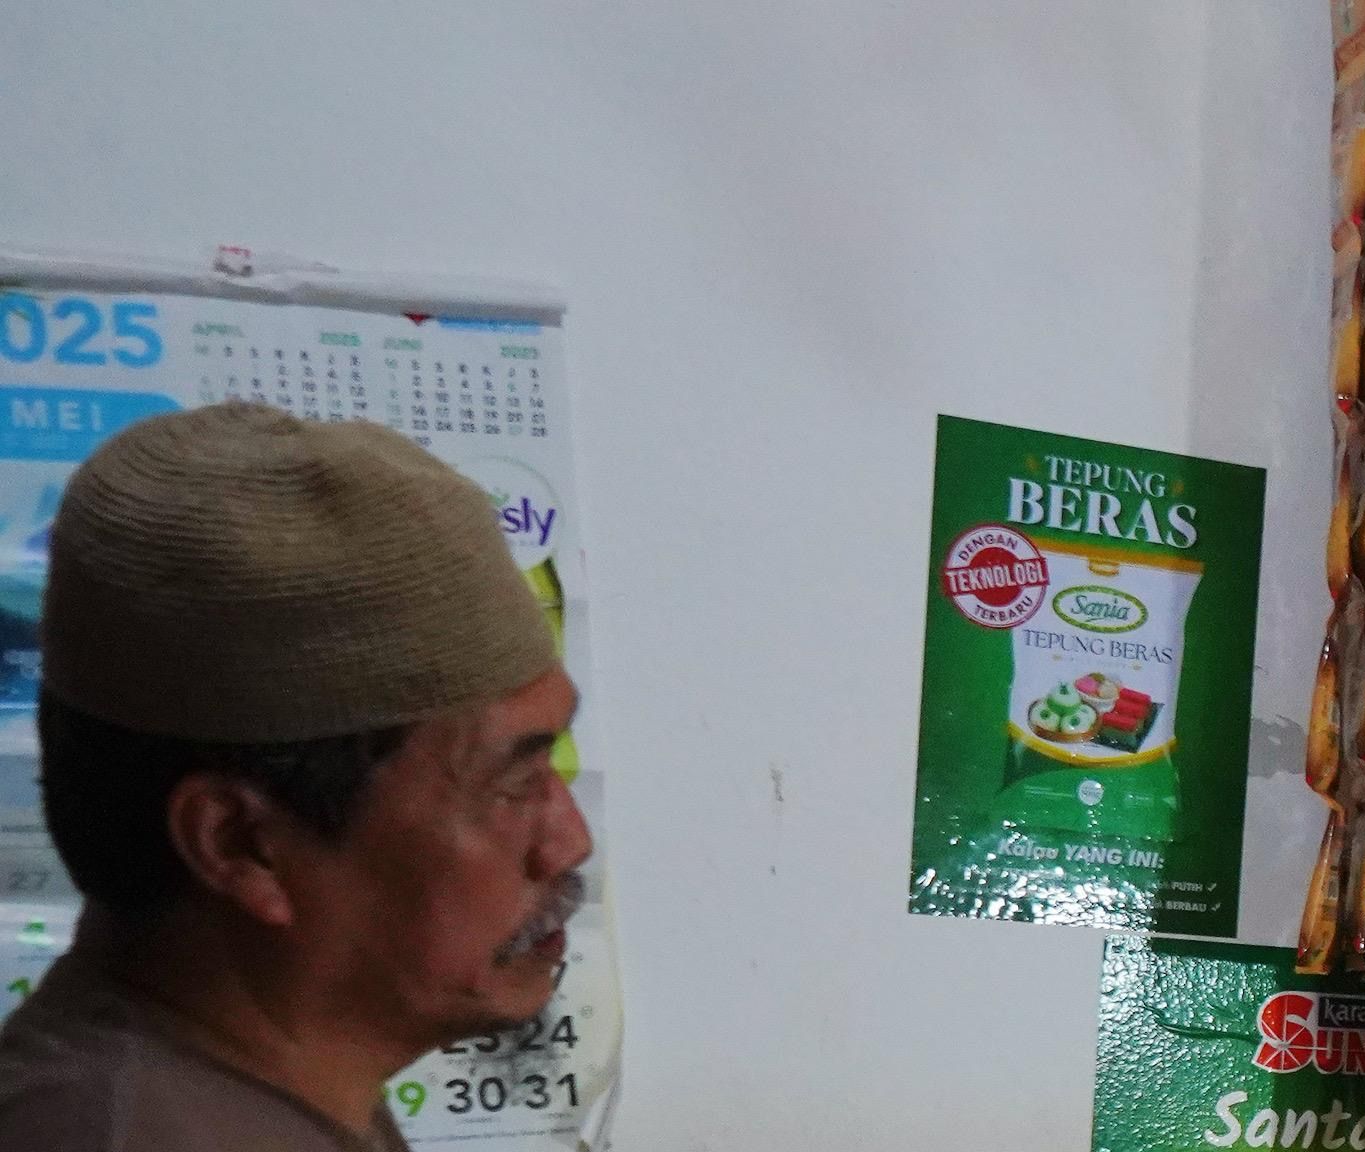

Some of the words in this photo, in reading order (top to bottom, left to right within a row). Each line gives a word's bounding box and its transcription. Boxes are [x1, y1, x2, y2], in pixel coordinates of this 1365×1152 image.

[11, 398, 104, 432] MEI
[1045, 454, 1166, 498] TEPUNG
[499, 496, 556, 546] sly
[1008, 477, 1199, 549] BERAS
[957, 532, 1019, 563] DENGAN
[945, 560, 1047, 595] TEKNOLOGI
[973, 594, 1034, 623] TERBARU
[1069, 593, 1132, 623] Sania
[1022, 628, 1106, 657] TEPUNG
[1109, 638, 1174, 665] BERAS
[1063, 843, 1123, 866] YANG
[384, 1080, 427, 1118] 9
[445, 1076, 507, 1114] 30
[522, 1072, 580, 1110] 31
